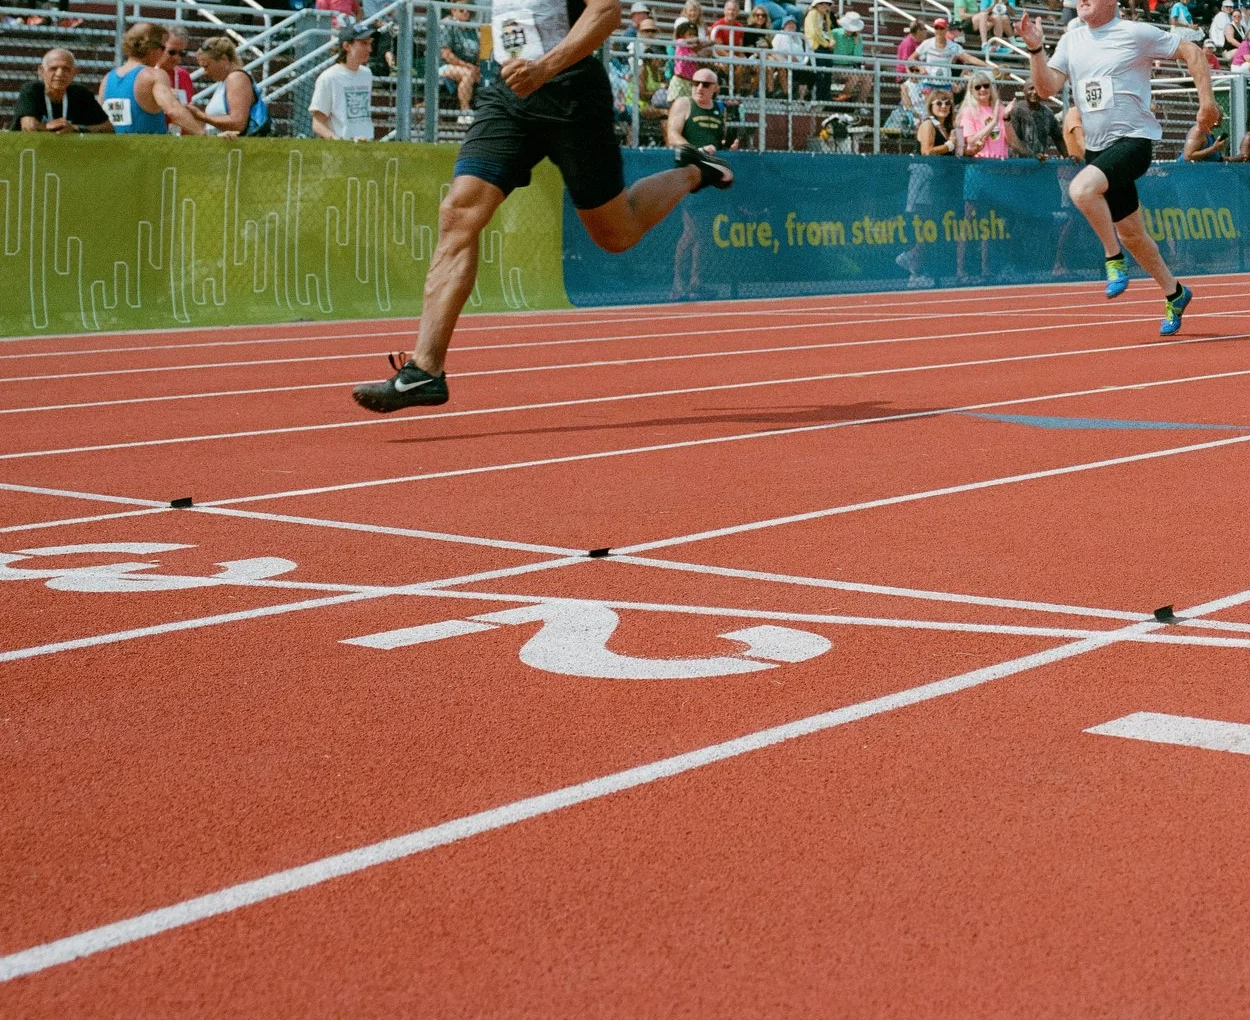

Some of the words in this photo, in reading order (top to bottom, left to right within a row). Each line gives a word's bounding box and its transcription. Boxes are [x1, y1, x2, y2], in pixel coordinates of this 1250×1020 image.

[1086, 87, 1102, 102] 397
[712, 214, 779, 254] Care,
[784, 212, 846, 246] from
[851, 214, 908, 245] start
[912, 214, 938, 244] to
[942, 209, 1011, 242] finish.
[1145, 207, 1237, 241] umana
